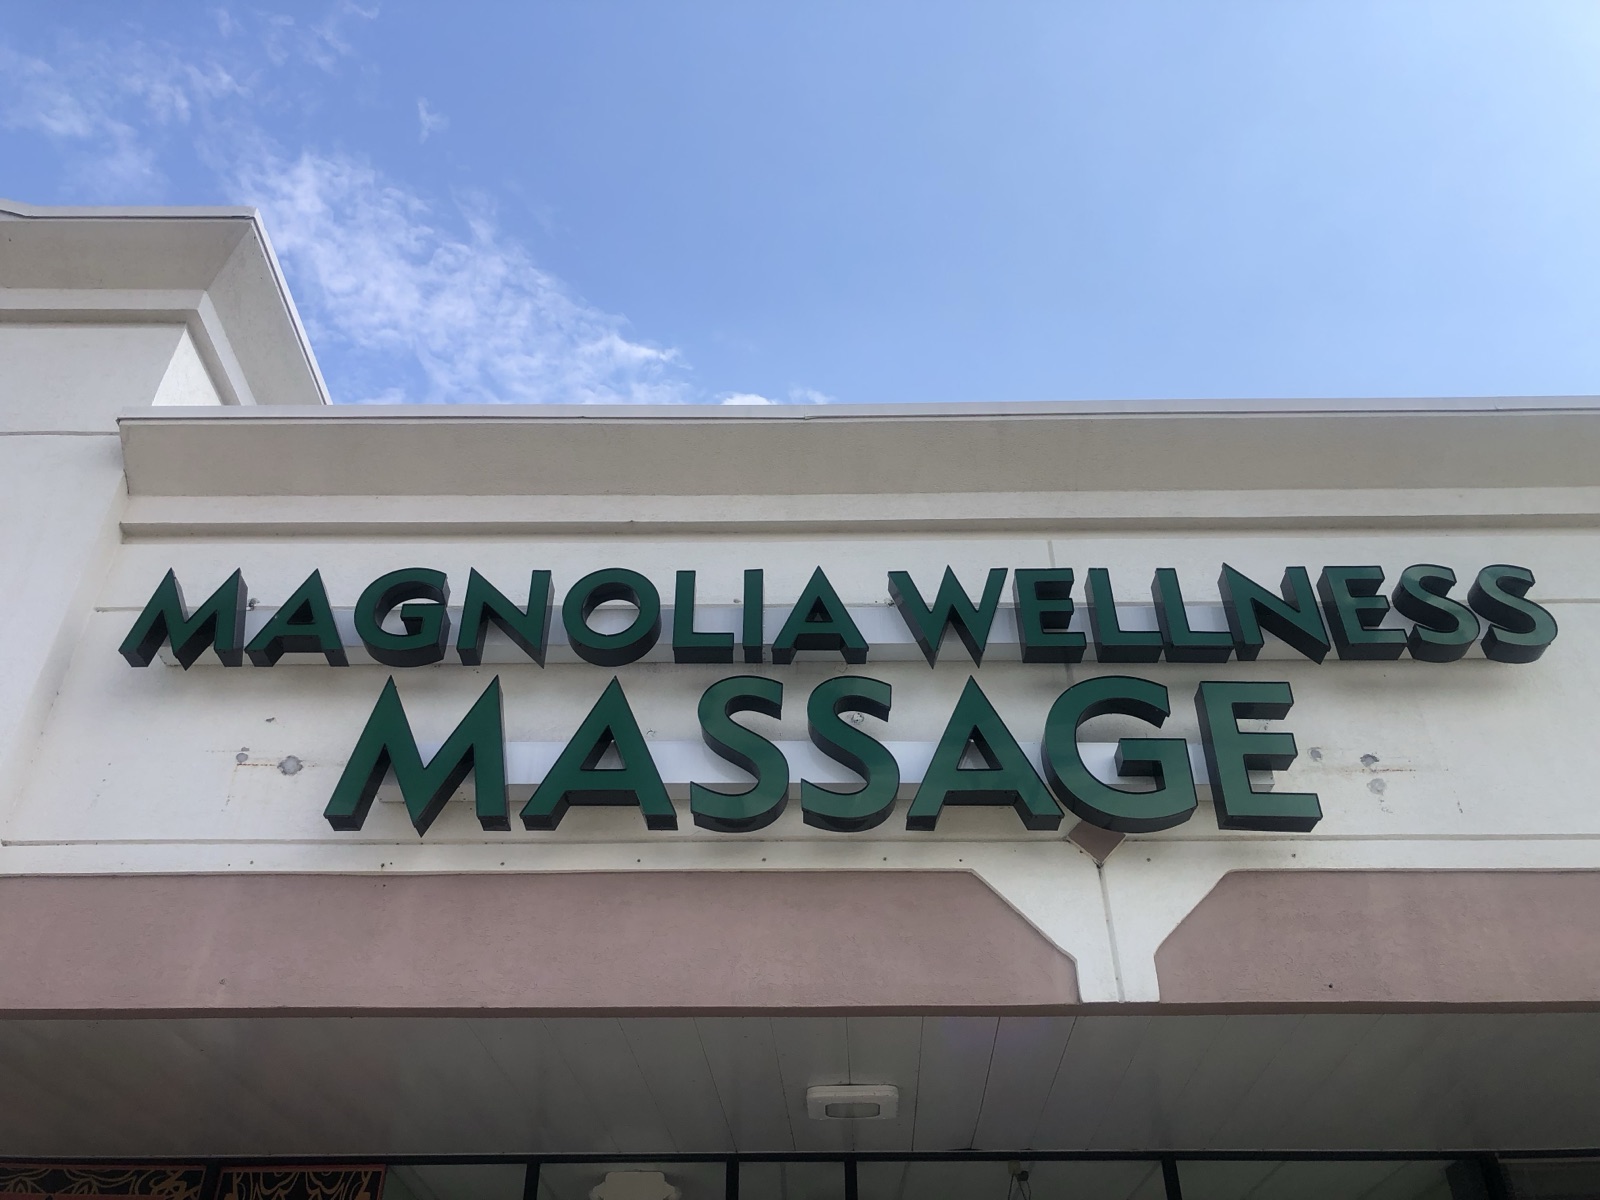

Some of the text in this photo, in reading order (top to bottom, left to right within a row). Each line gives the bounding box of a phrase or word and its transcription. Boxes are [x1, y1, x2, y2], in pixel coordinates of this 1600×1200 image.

[119, 564, 1558, 668] MAGNOLIA WELLNESS
[324, 675, 1322, 837] MASSAGE
